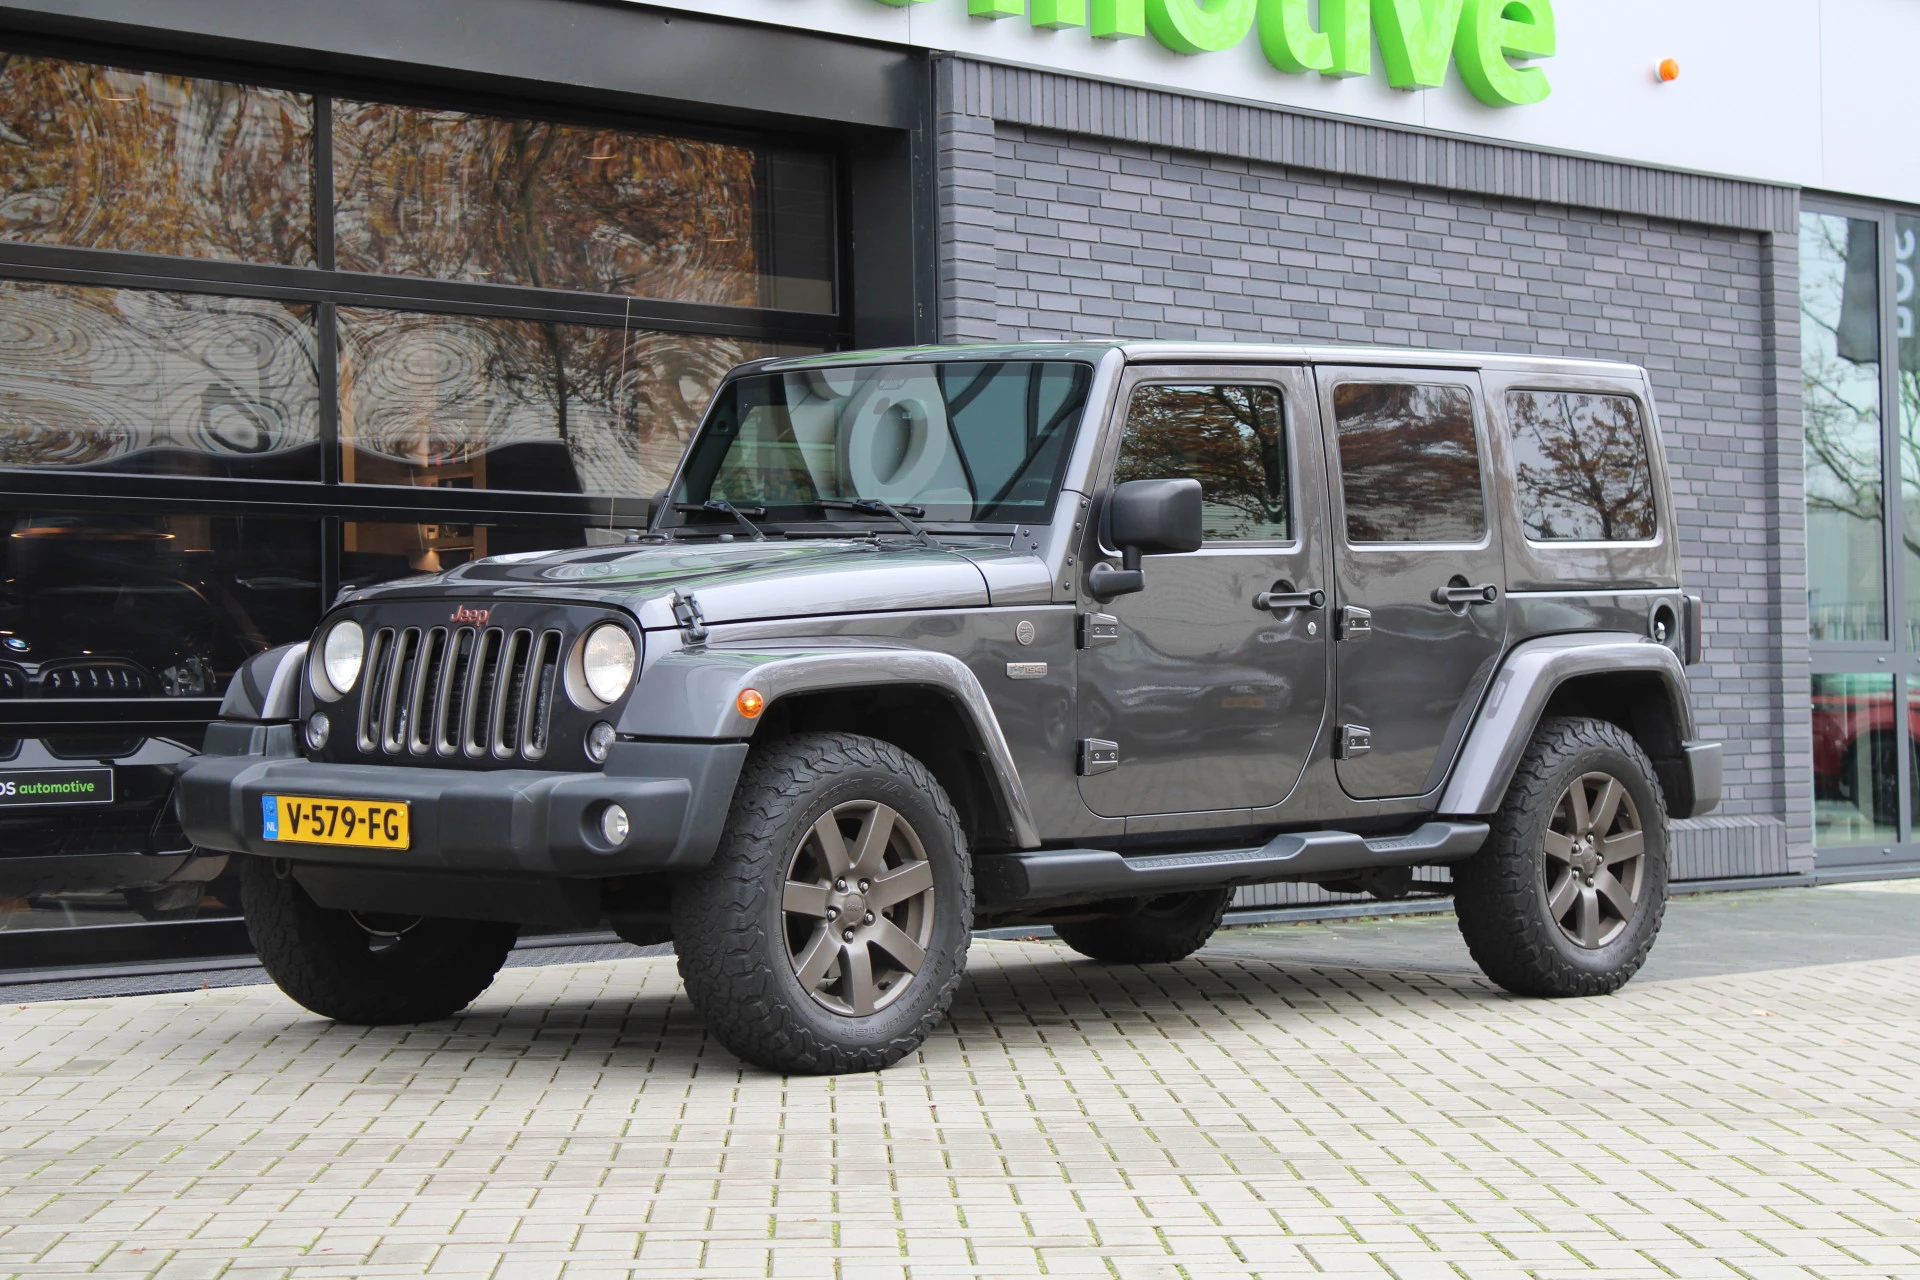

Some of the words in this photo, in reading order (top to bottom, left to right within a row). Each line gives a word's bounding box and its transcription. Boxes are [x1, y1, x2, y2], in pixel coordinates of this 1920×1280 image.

[450, 604, 489, 627] Jeep
[19, 780, 95, 794] automotive
[266, 821, 277, 832] NL
[286, 802, 399, 841] V-579-FG
